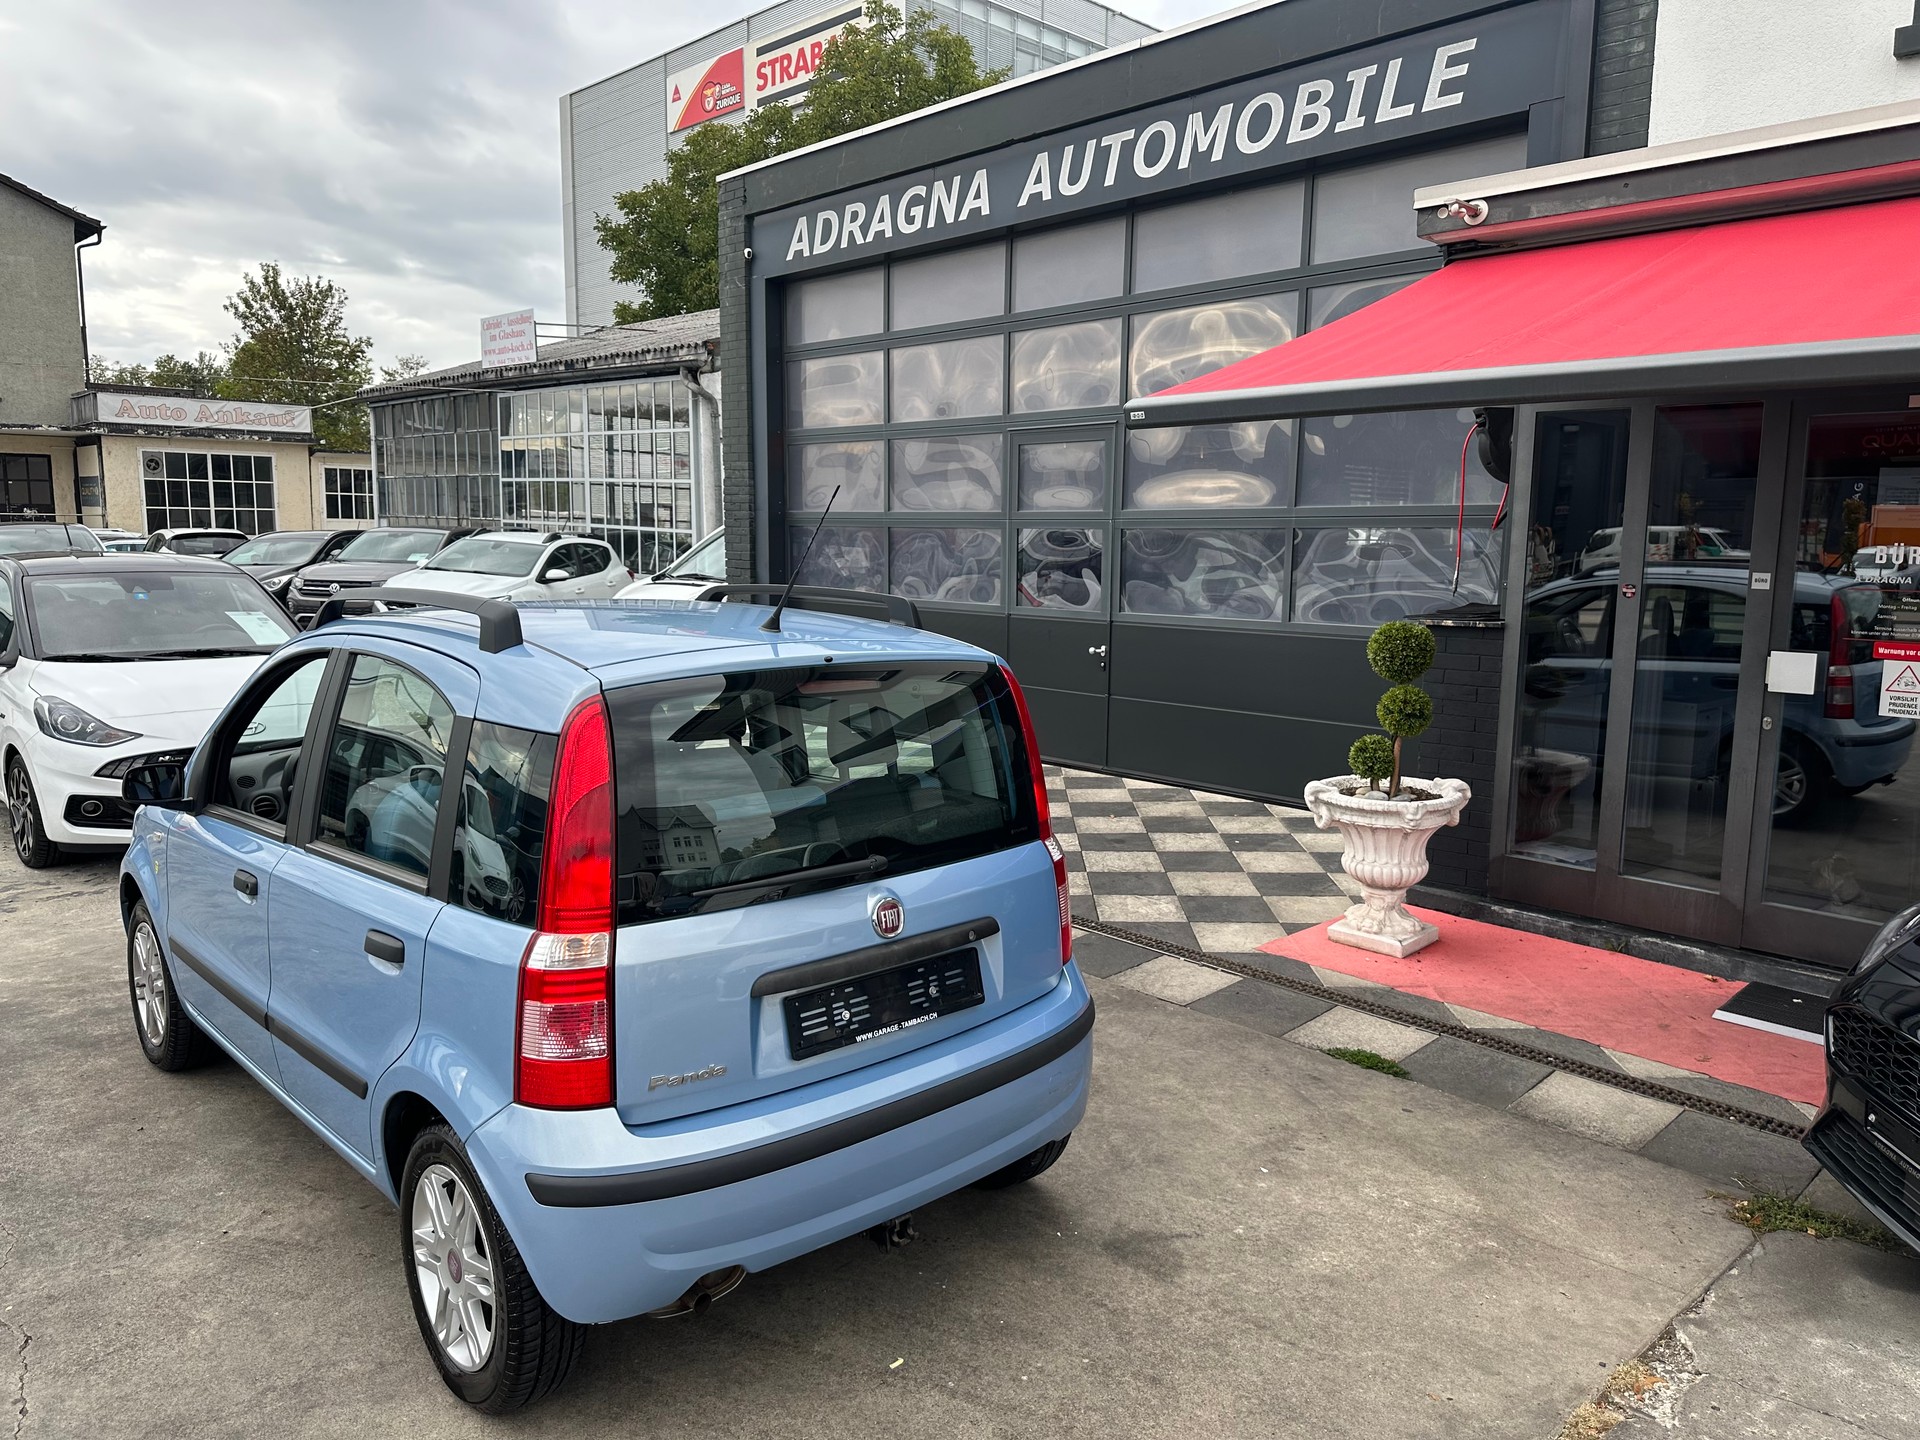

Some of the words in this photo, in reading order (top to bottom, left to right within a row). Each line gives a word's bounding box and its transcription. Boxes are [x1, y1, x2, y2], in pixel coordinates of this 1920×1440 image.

[716, 93, 741, 109] ZURIQUE
[786, 168, 990, 261] ADRAGNA
[1017, 37, 1477, 208] AUTOMOBILE
[115, 399, 187, 421] Auto
[194, 404, 295, 427] Ankauf
[1878, 647, 1905, 656] Warnung
[1888, 708, 1917, 716] PRUDENZA
[880, 907, 899, 929] FIAT
[647, 1063, 728, 1092] Panda
